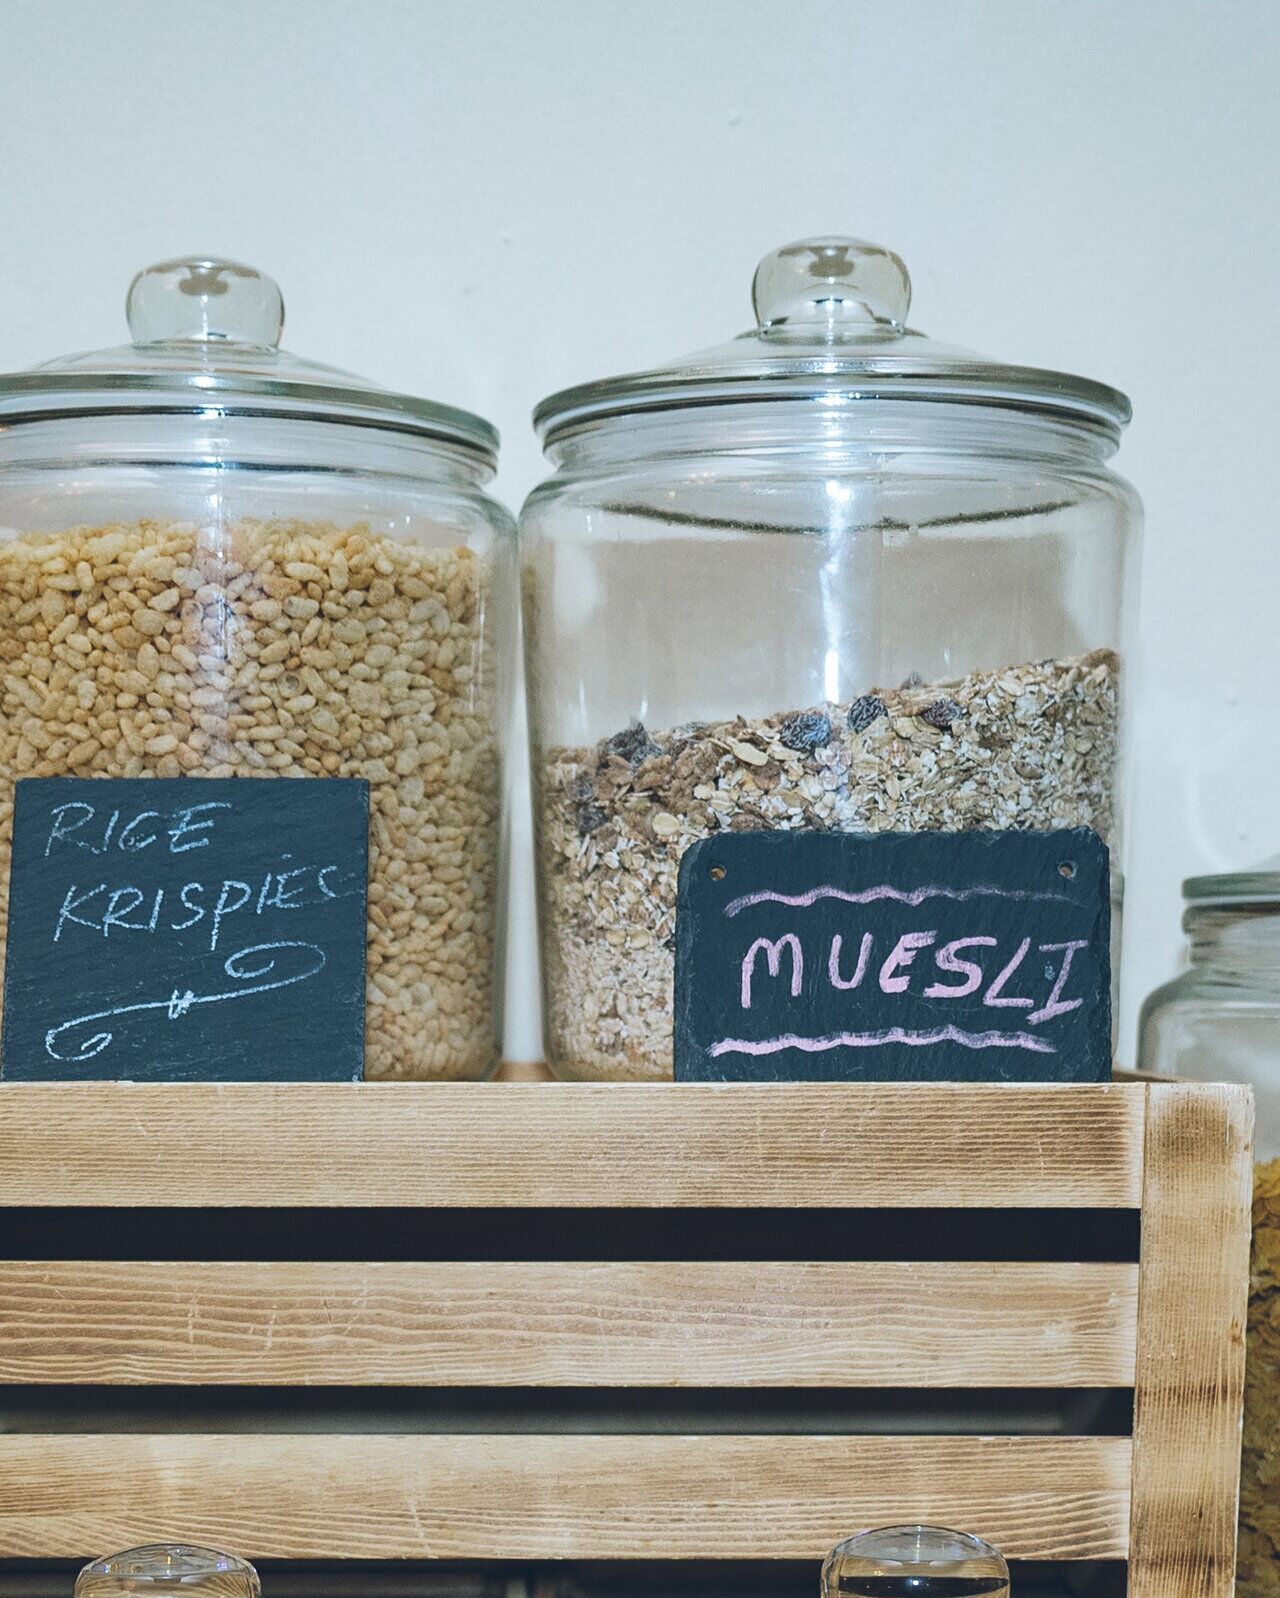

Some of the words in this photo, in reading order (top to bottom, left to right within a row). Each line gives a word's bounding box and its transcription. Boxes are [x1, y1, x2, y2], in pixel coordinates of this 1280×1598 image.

[44, 802, 232, 856] RICE
[53, 855, 352, 950] KRISPIES
[742, 930, 1088, 1024] MUESLI
